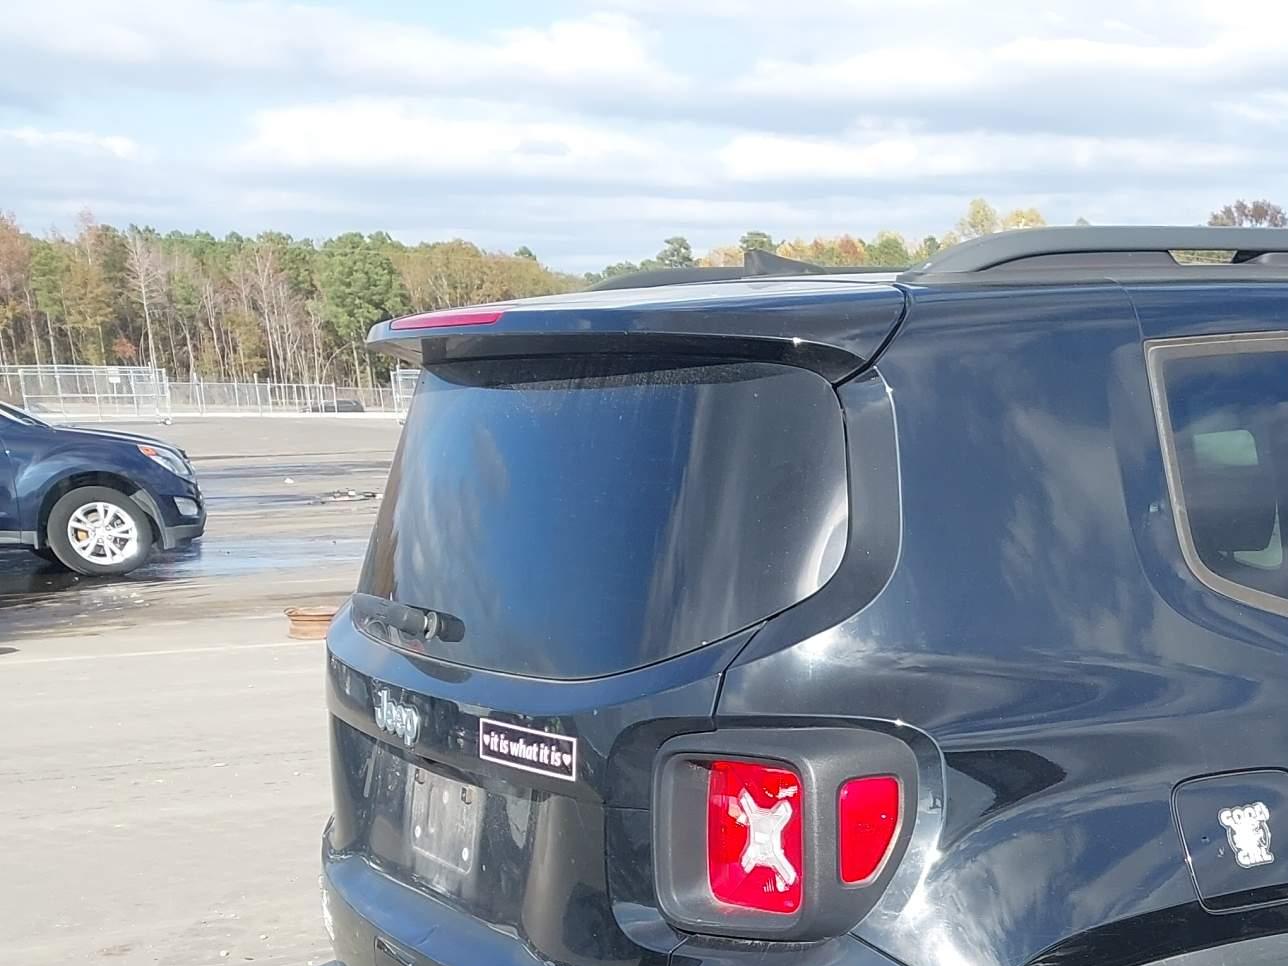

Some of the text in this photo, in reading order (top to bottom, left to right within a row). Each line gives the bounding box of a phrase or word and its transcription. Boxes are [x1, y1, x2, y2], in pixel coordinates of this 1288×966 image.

[374, 689, 419, 746] Jeep
[489, 731, 562, 767] it is what it is
